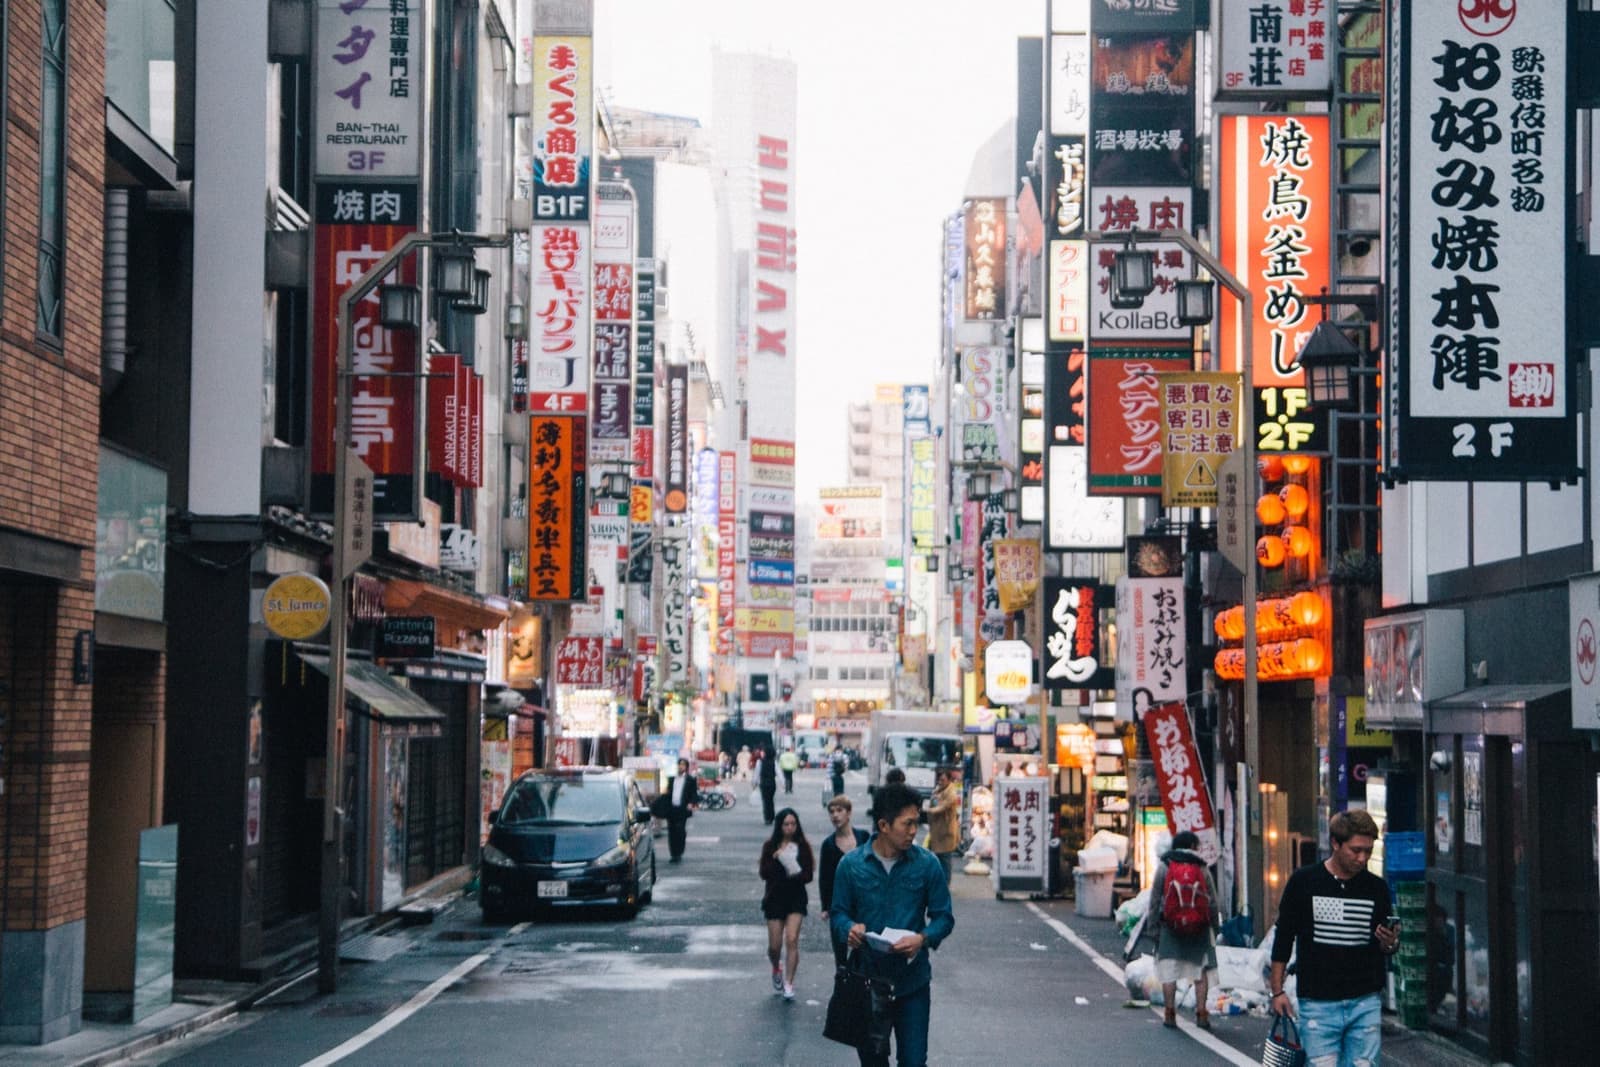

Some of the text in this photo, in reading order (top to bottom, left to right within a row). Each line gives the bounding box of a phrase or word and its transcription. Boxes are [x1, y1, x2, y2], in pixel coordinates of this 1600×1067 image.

[1249, 4, 1283, 87] 南荘
[1225, 72, 1244, 88] 3F
[544, 44, 577, 185] まぐろ商店
[336, 122, 399, 132] BAN-THAI
[1510, 46, 1546, 213] 歌舞伎町名物
[326, 135, 408, 145] RESTAURANT
[1094, 129, 1184, 150] 酒場牧場
[347, 151, 385, 170] 3F
[333, 189, 401, 221] 焼肉
[537, 195, 585, 216] B1F
[1261, 120, 1311, 375] 焼鳥釜めし
[1058, 244, 1078, 335] クアトロ
[1099, 311, 1184, 330] KollaBo
[612, 325, 626, 378] レンタル
[544, 394, 573, 411] 4F
[600, 384, 618, 424] エデン
[1166, 384, 1234, 405] 悪質な
[1117, 362, 1163, 475] ステップ
[1166, 409, 1234, 430] 客引き
[1166, 433, 1234, 454] に注意
[1258, 422, 1315, 450] 2F
[1451, 422, 1515, 458] 2F
[1132, 475, 1149, 487] B1
[383, 632, 430, 646] Pizzeria
[1150, 586, 1184, 689] お好み焼き
[1154, 714, 1206, 834] お好み焼
